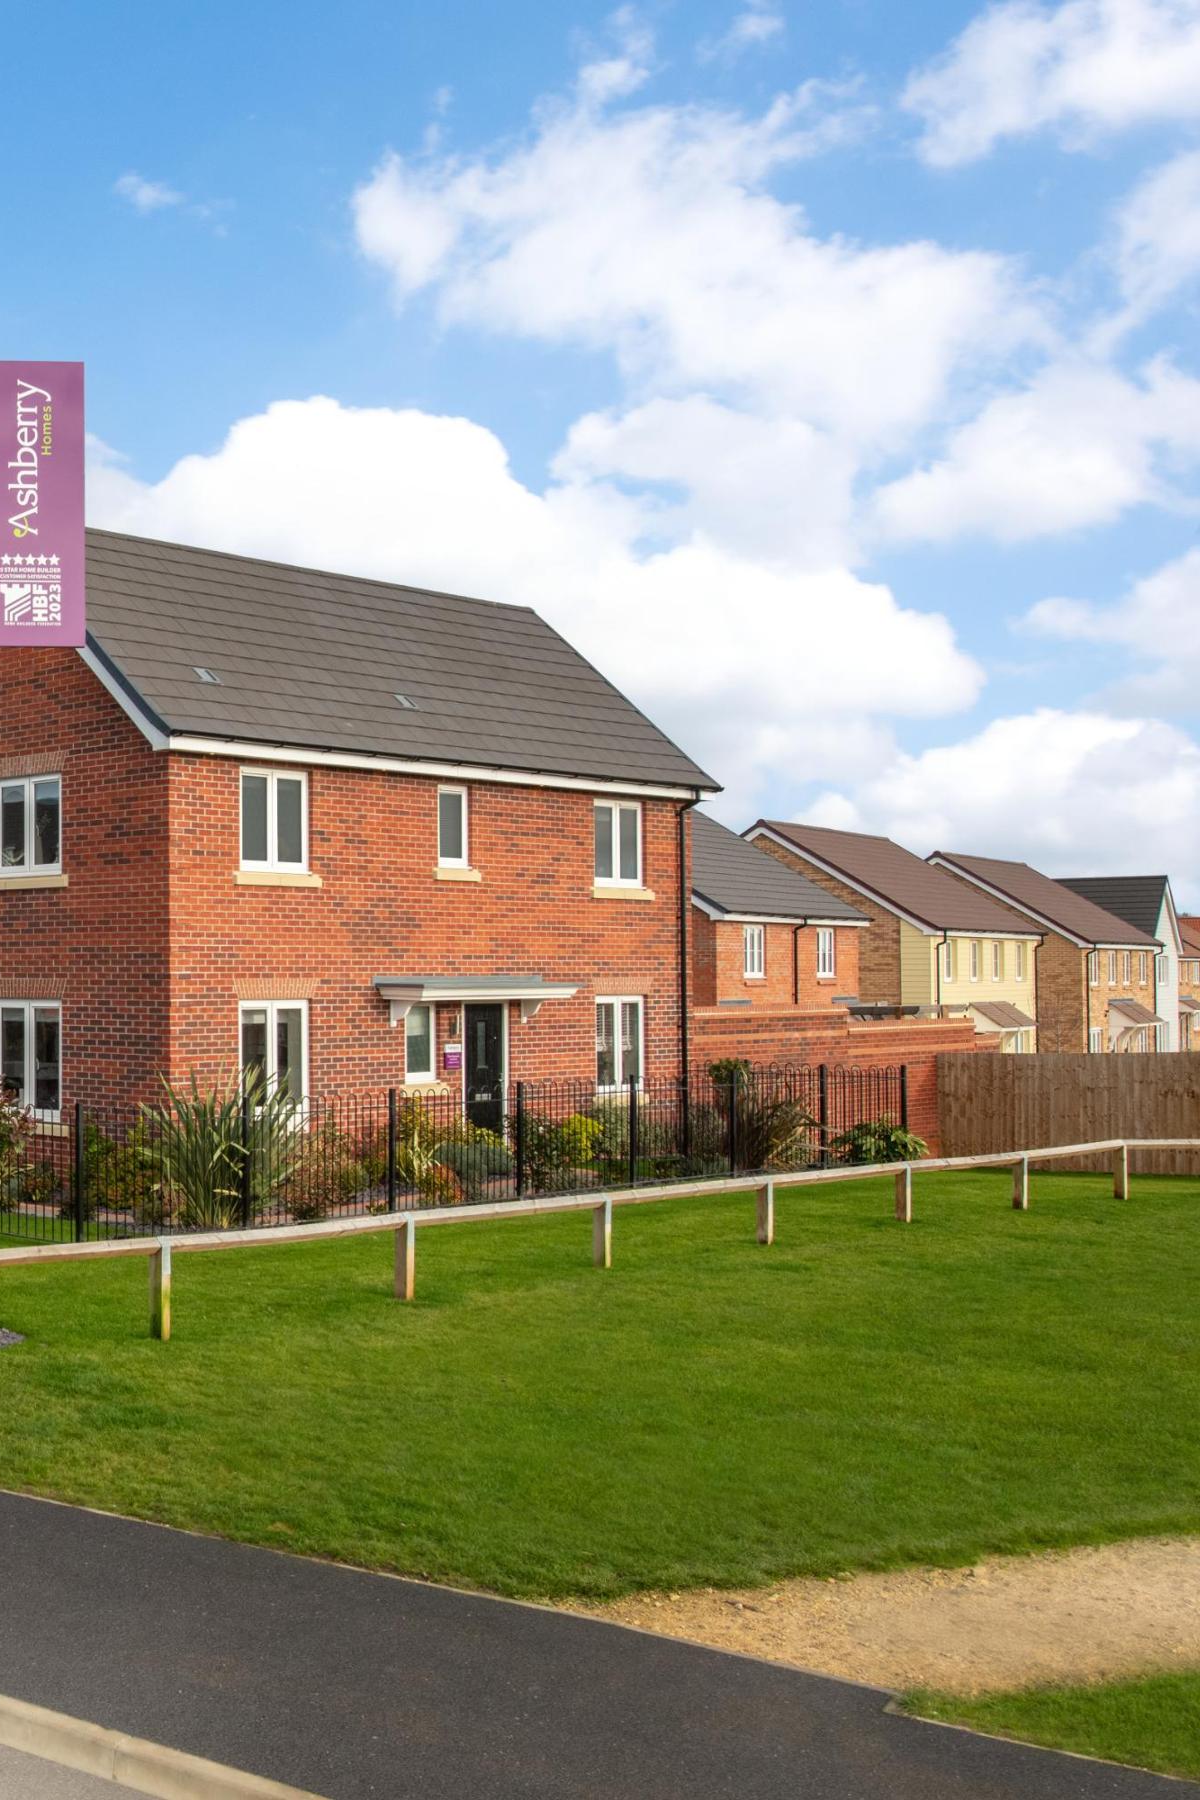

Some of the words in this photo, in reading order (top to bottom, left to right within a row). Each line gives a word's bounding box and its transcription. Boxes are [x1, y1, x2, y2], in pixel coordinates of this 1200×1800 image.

[41, 405, 52, 456] Homes
[8, 379, 52, 538] Ashberry
[32, 584, 48, 622] HBF
[49, 584, 61, 622] 2023
